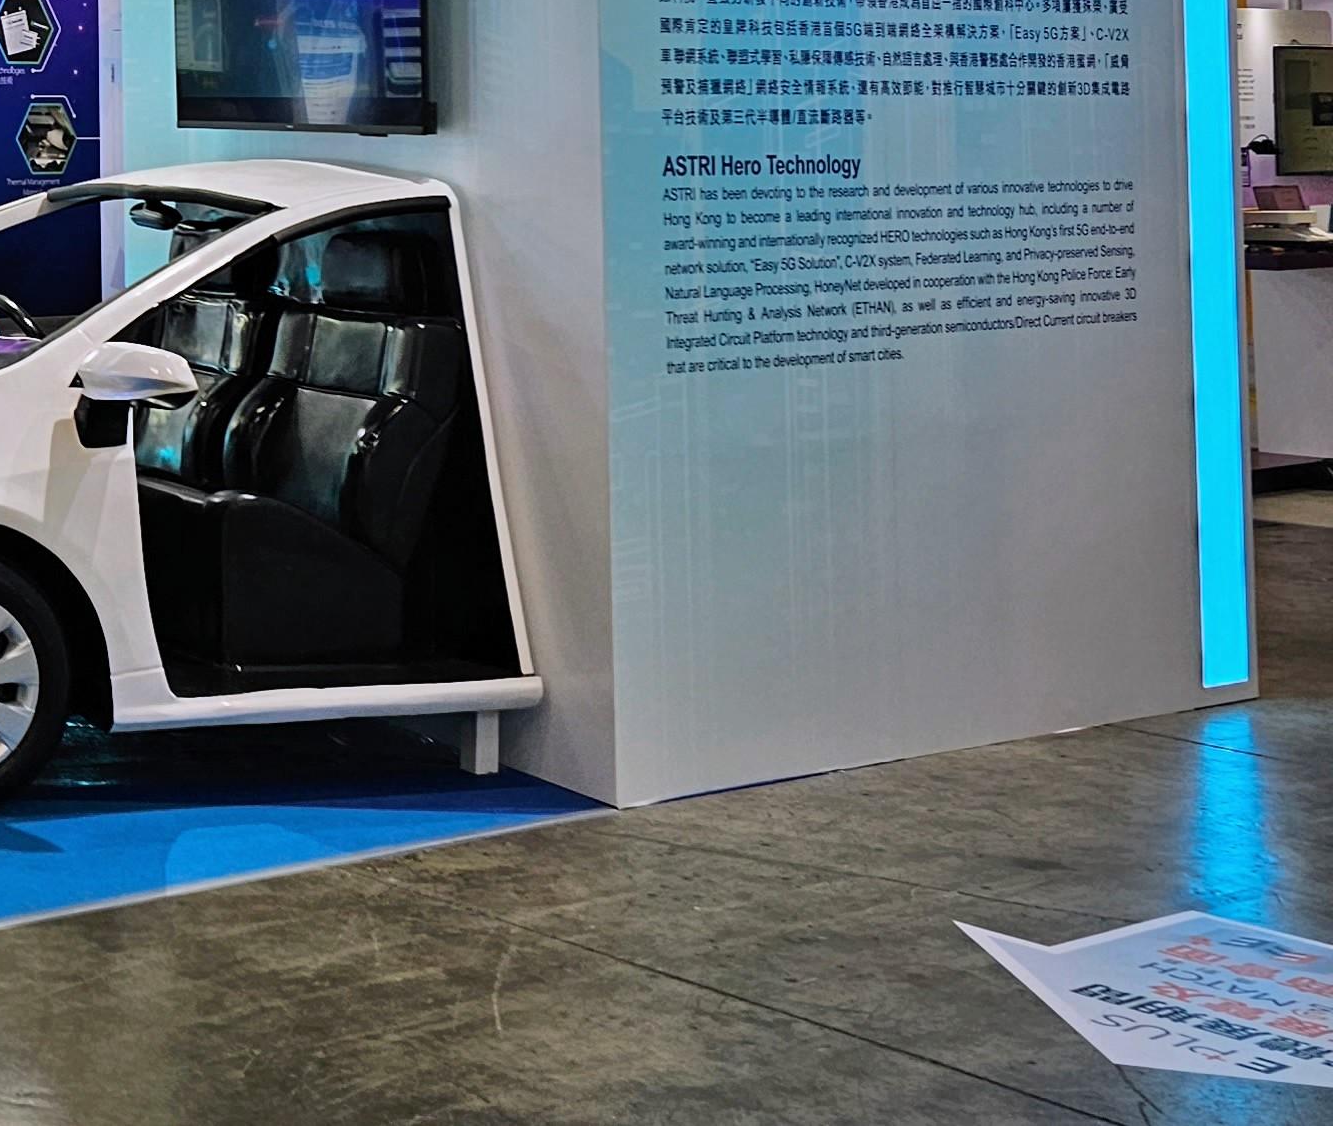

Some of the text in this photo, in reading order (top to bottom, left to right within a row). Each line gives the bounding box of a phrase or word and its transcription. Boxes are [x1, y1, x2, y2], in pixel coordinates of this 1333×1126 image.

[662, 154, 861, 178] ASTRI Hero Technology
